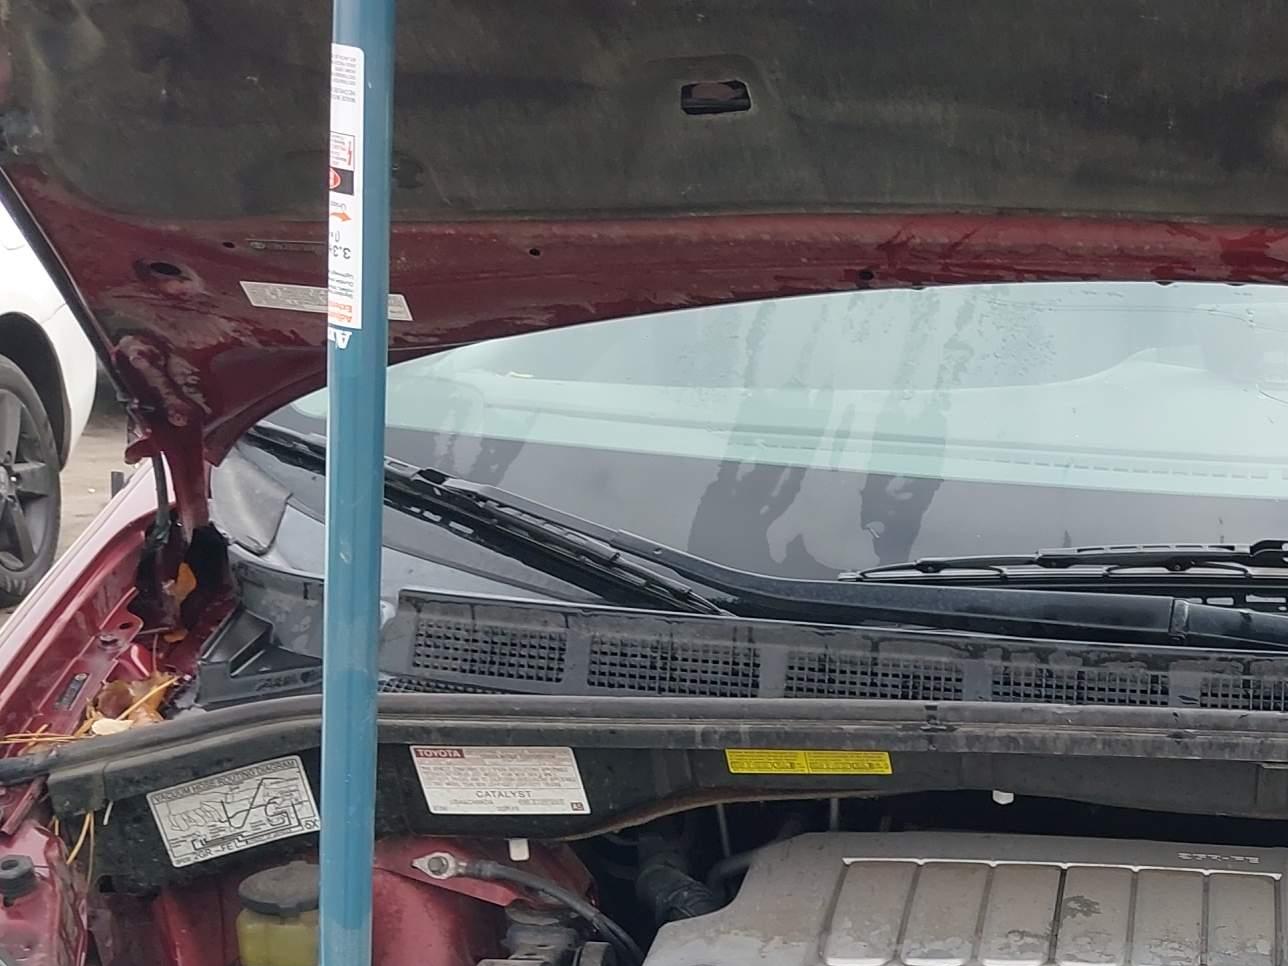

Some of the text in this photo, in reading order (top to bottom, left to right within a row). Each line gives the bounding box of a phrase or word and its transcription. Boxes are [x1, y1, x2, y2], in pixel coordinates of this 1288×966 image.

[415, 749, 461, 758] TOYOTA
[155, 786, 191, 803] VACUUM
[215, 767, 258, 785] ROUTING
[258, 759, 296, 774] DIAGRAM
[475, 790, 534, 799] CATALYST
